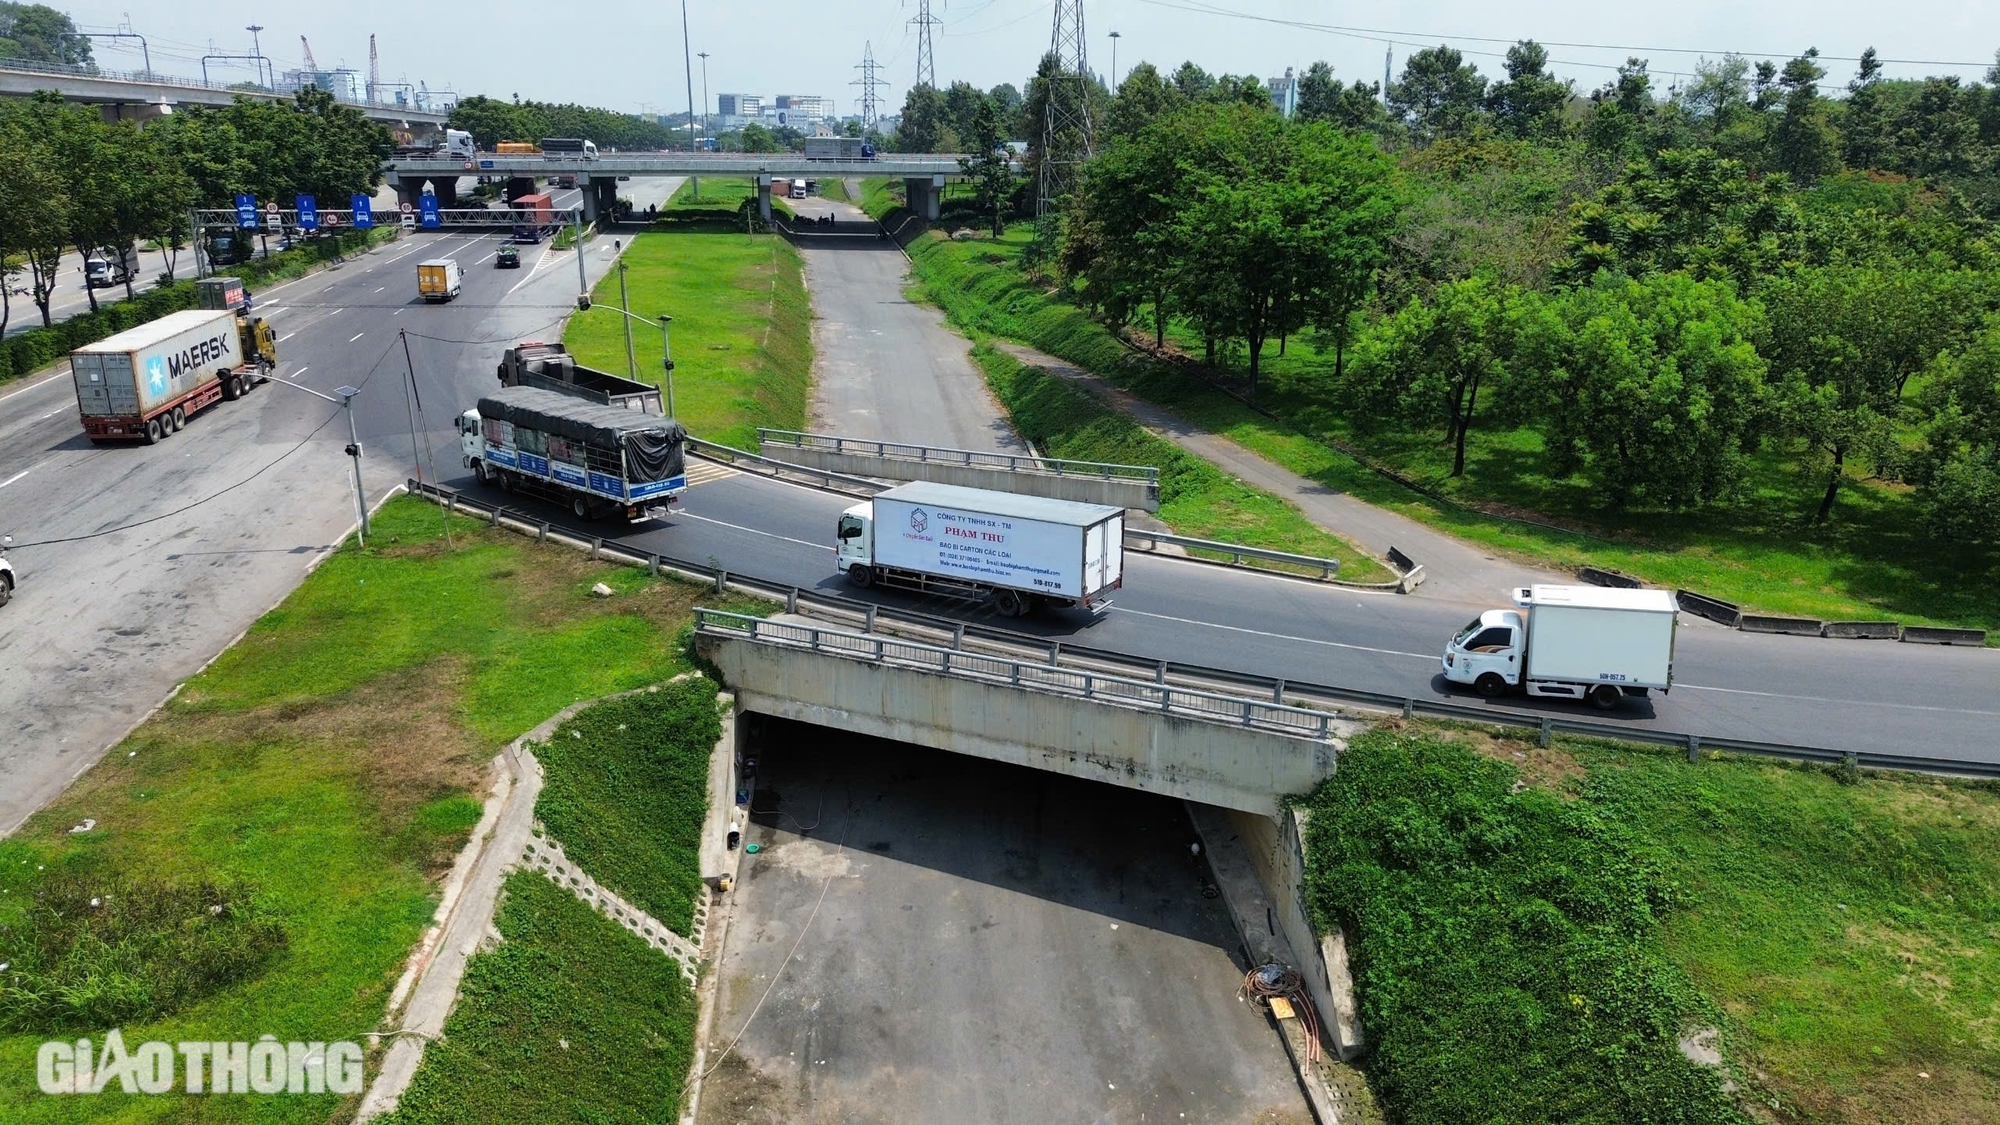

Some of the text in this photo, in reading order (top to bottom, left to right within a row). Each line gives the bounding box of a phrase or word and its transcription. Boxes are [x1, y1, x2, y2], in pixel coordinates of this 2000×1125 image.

[168, 333, 229, 379] MAERSK
[937, 512, 956, 521] CÔNG
[968, 517, 986, 526] TNHH
[1002, 522, 1012, 530] TM
[944, 526, 977, 539] PHẠM
[980, 532, 1005, 543] THU
[939, 541, 952, 549] BAO
[960, 544, 983, 554] CARTON
